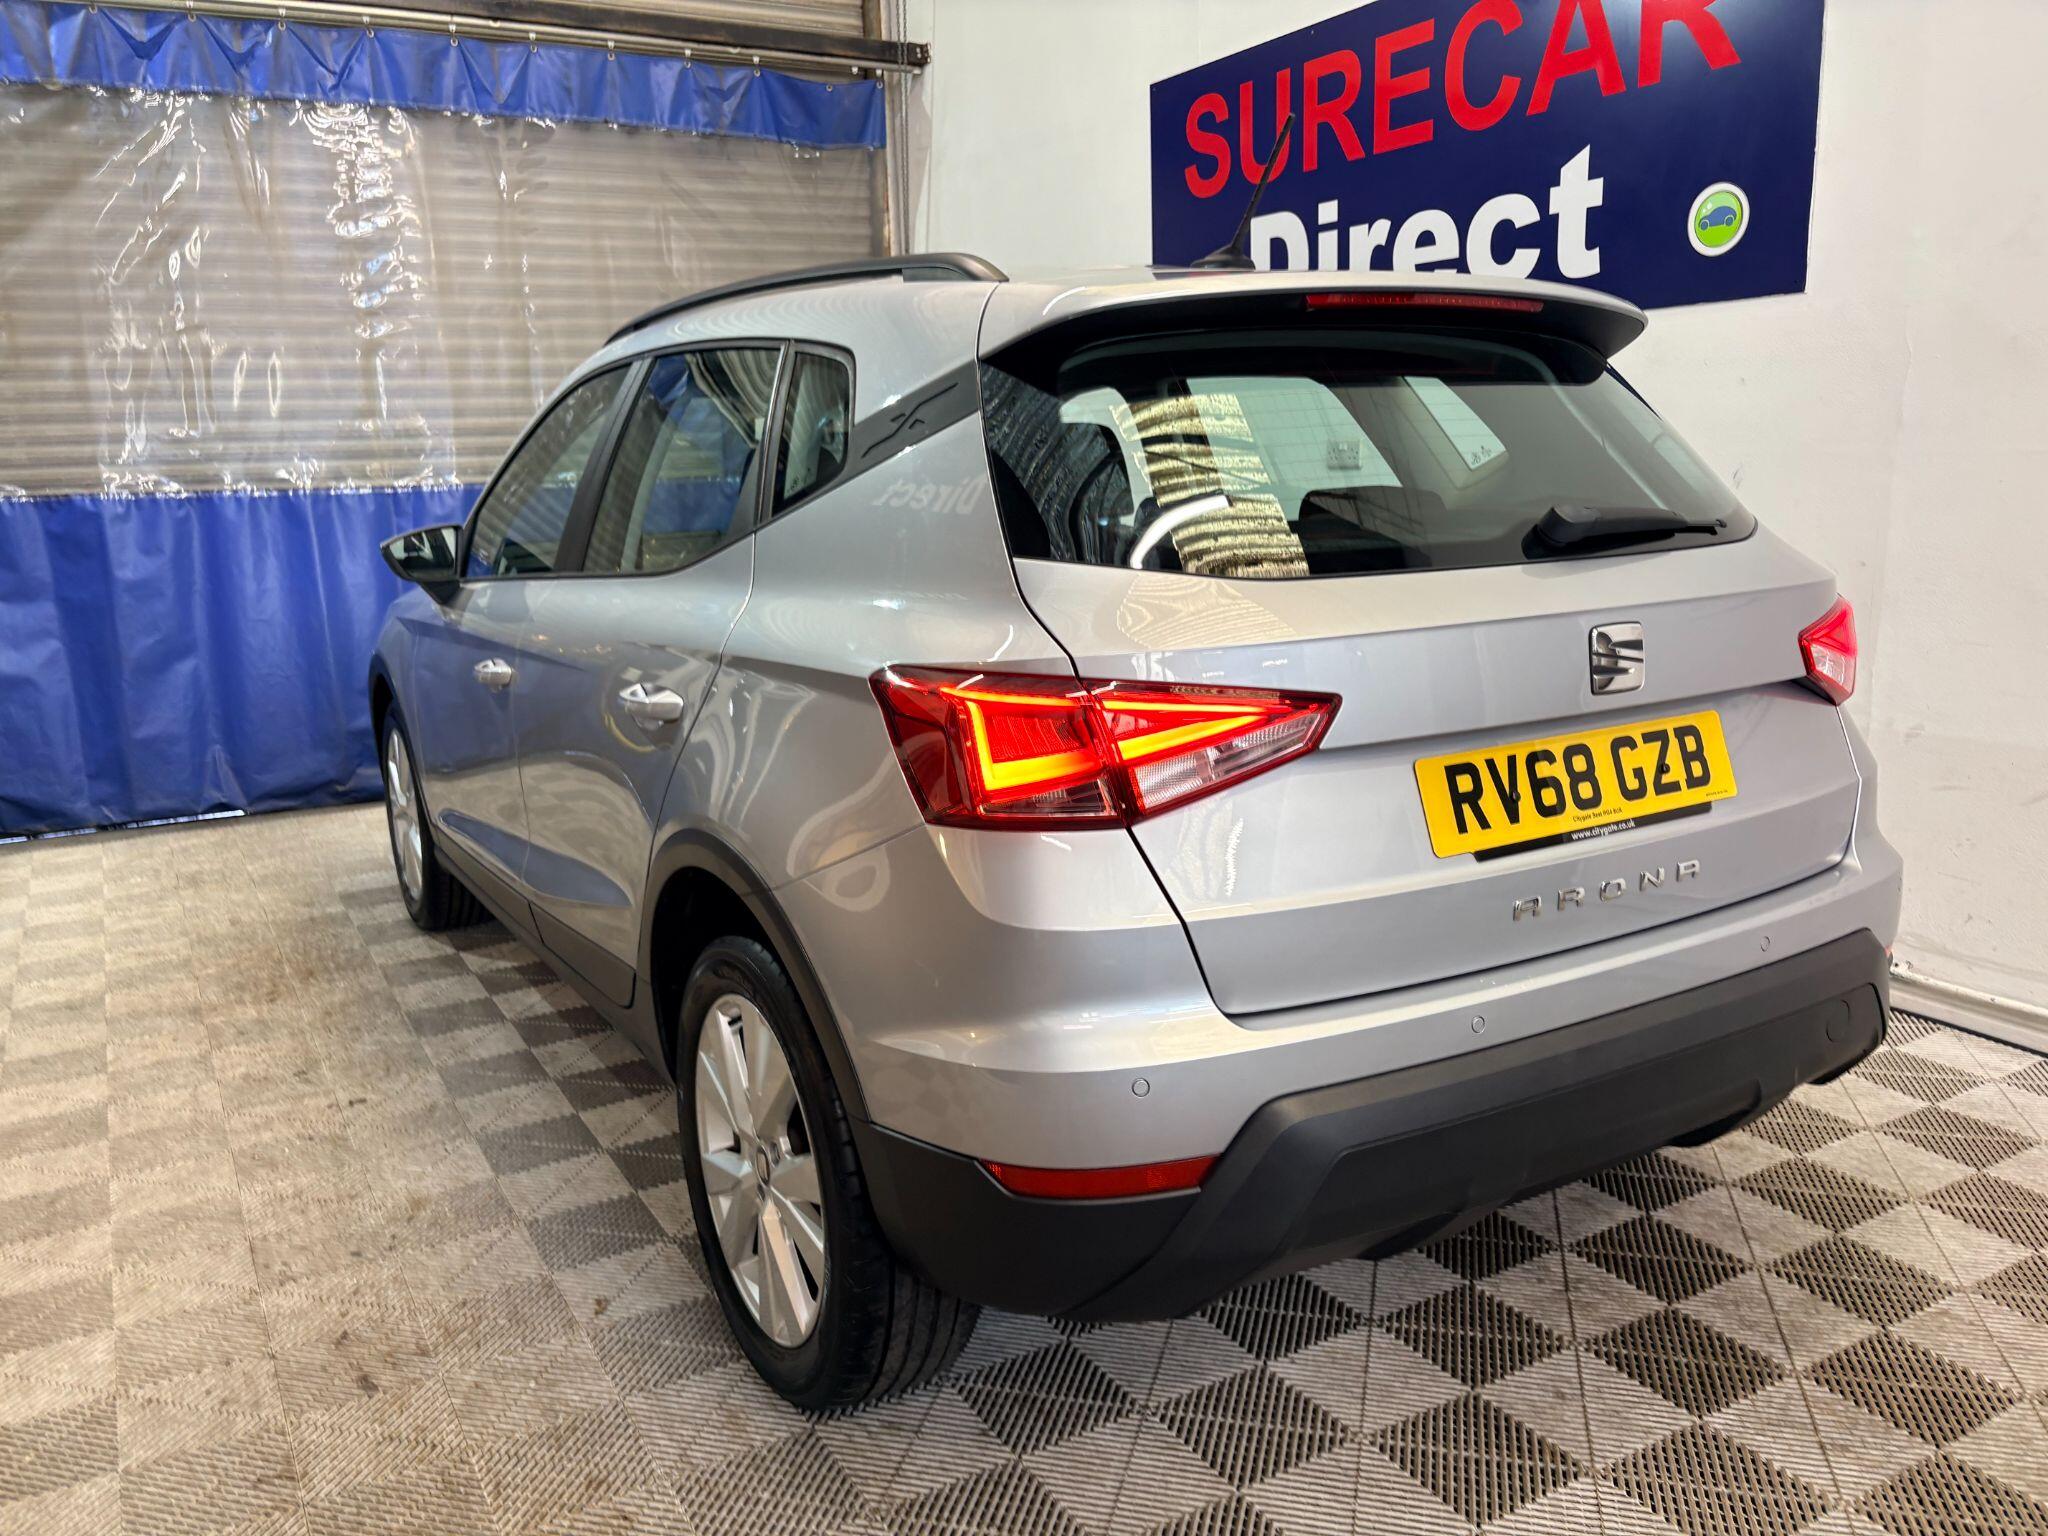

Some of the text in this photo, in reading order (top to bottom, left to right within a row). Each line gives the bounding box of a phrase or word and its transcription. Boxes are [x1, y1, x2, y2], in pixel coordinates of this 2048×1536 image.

[1184, 0, 1742, 199] SURECAR
[1250, 144, 1604, 279] Direct
[1443, 724, 1712, 834] RV68 GZB
[1571, 818, 1636, 840] www.citygate.co.uk
[1513, 858, 1701, 921] ARONA
